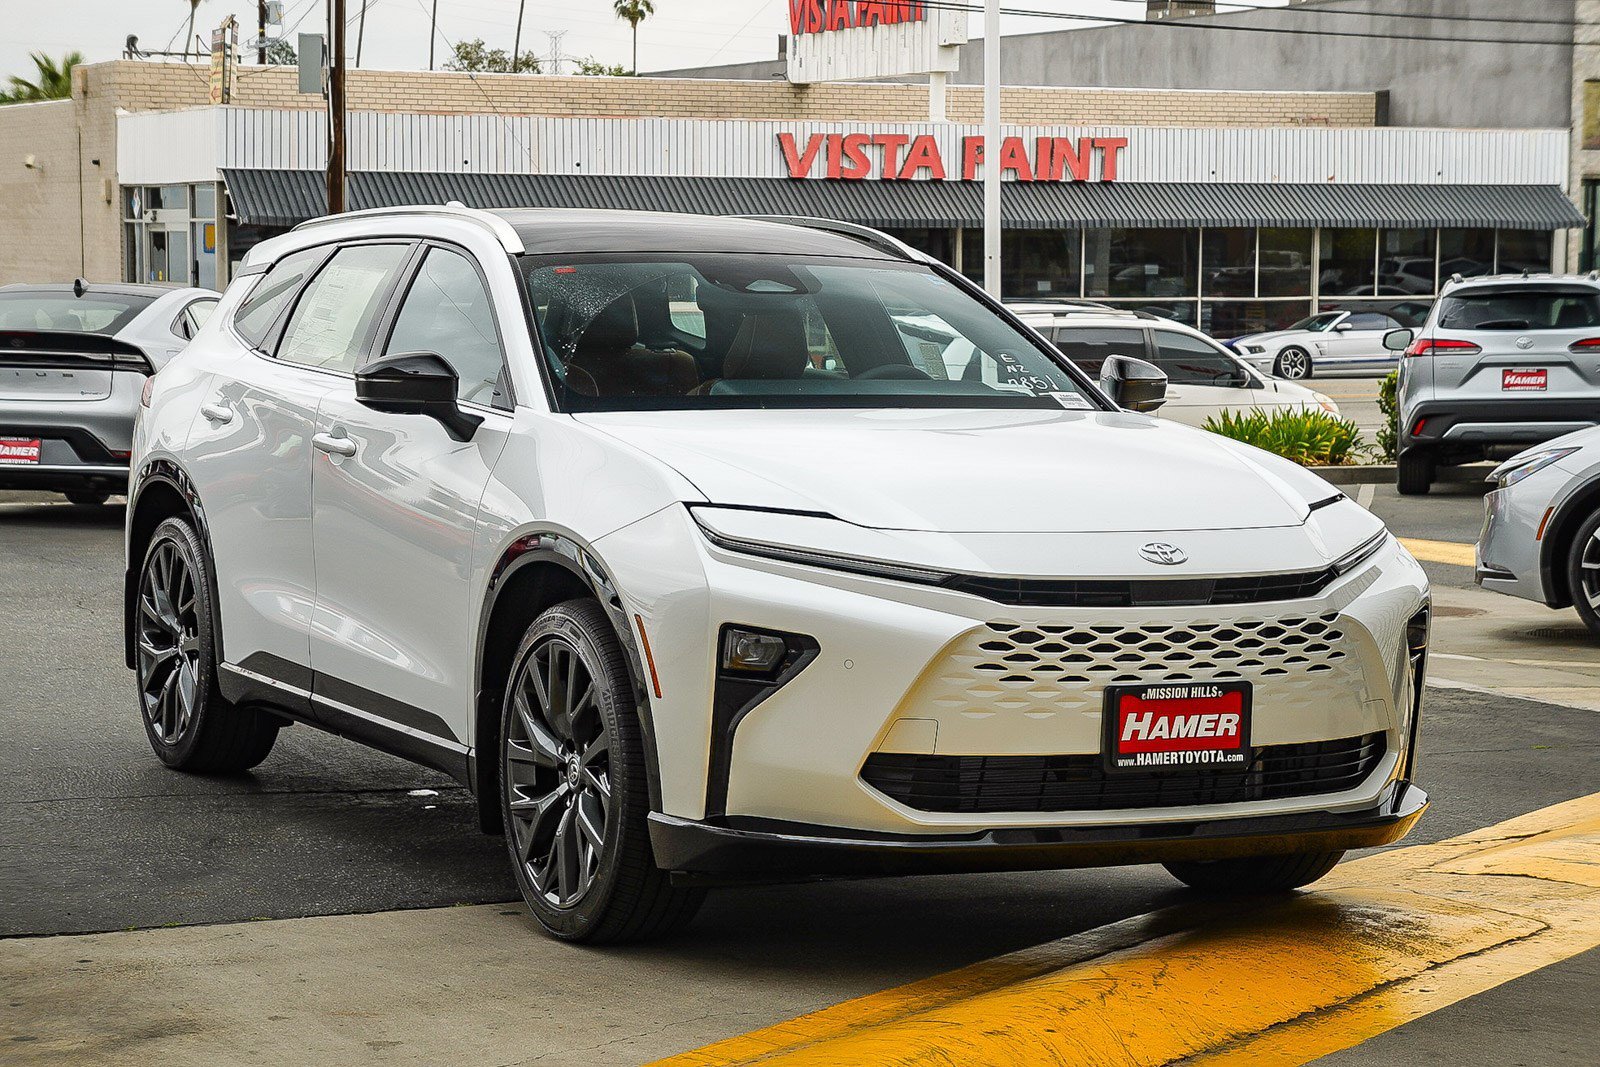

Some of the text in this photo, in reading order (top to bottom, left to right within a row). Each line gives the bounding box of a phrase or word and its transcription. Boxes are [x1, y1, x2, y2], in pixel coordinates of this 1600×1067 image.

[788, 0, 925, 35] VISTA PAINT
[777, 132, 1128, 182] VISTA PAINT
[1504, 375, 1546, 385] HAMER
[1146, 686, 1218, 700] MISSION HILLS
[1121, 712, 1240, 741] HAMER
[1117, 750, 1244, 767] www.HAMERTOYOTA.com
